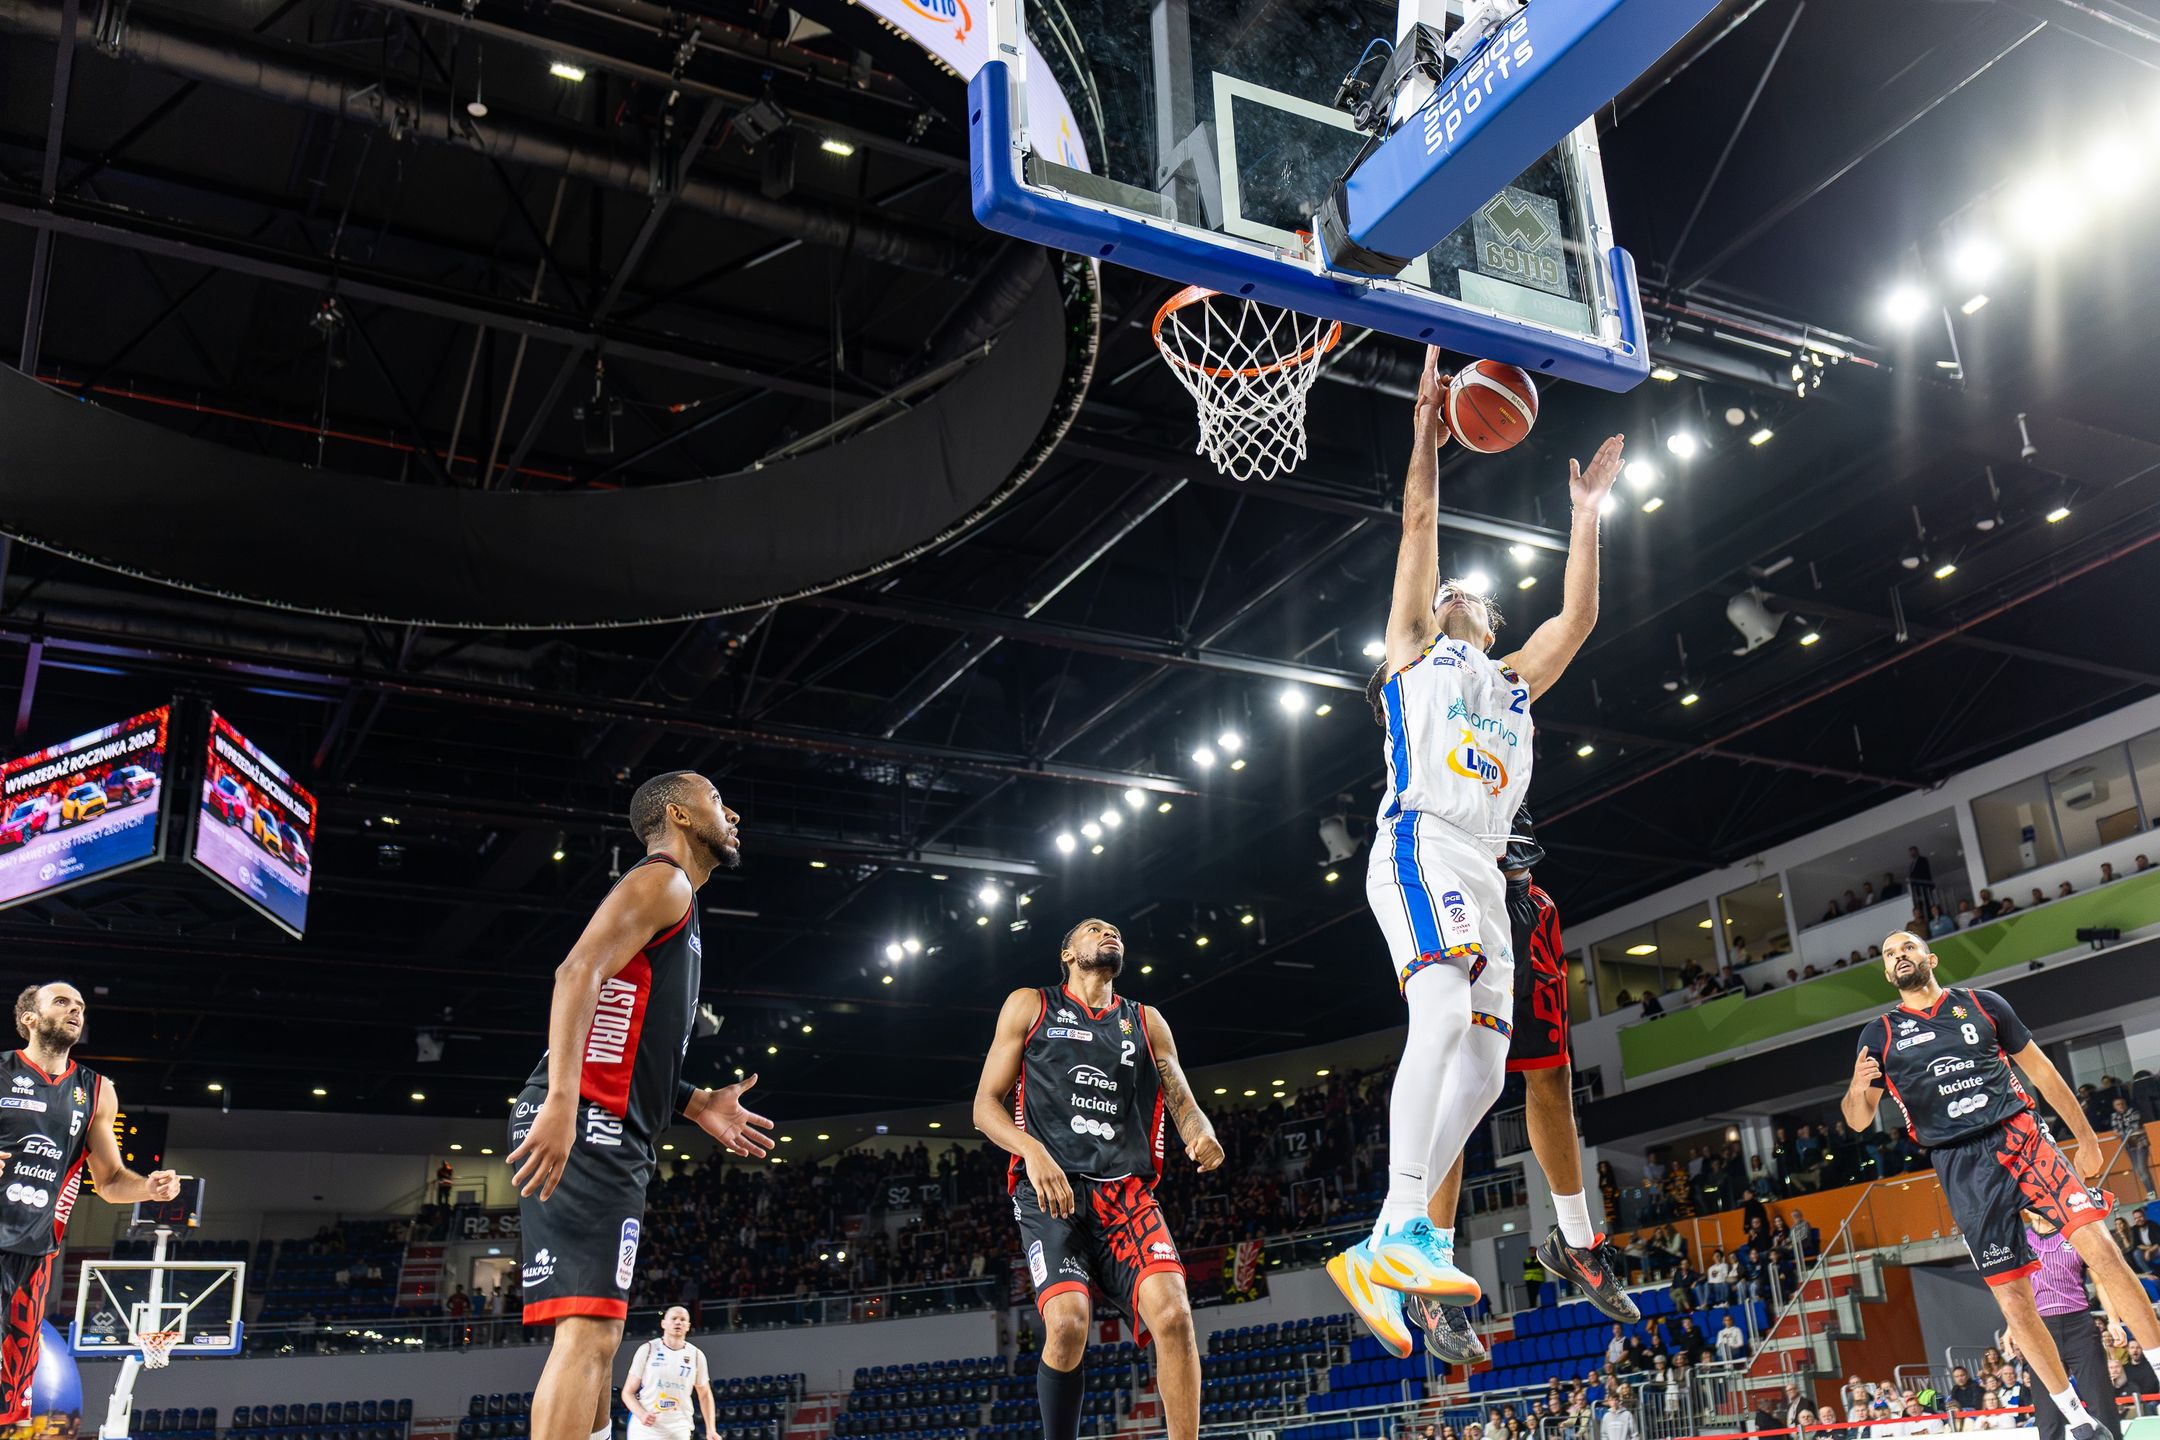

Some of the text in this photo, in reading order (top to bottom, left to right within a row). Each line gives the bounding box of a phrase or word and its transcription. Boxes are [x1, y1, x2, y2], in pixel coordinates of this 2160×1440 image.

[1425, 39, 1534, 156] sports
[1436, 658, 1455, 666] PGE
[1509, 688, 1528, 715] 2
[1471, 712, 1517, 747] arriva
[5, 728, 157, 795] WYPRZEDAŻ ROCZNIKA 2026
[1445, 894, 1461, 903] PGE
[585, 978, 637, 1064] ASTORIA
[1960, 1023, 1980, 1045] 8
[1120, 1040, 1136, 1067] 2
[1934, 1059, 1975, 1077] Enea
[1075, 1071, 1118, 1092] Enea
[69, 1110, 84, 1137] 5
[23, 1140, 63, 1160] Enea
[888, 1186, 910, 1205] S2
[464, 1216, 490, 1234] R2
[680, 1365, 692, 1378] 77
